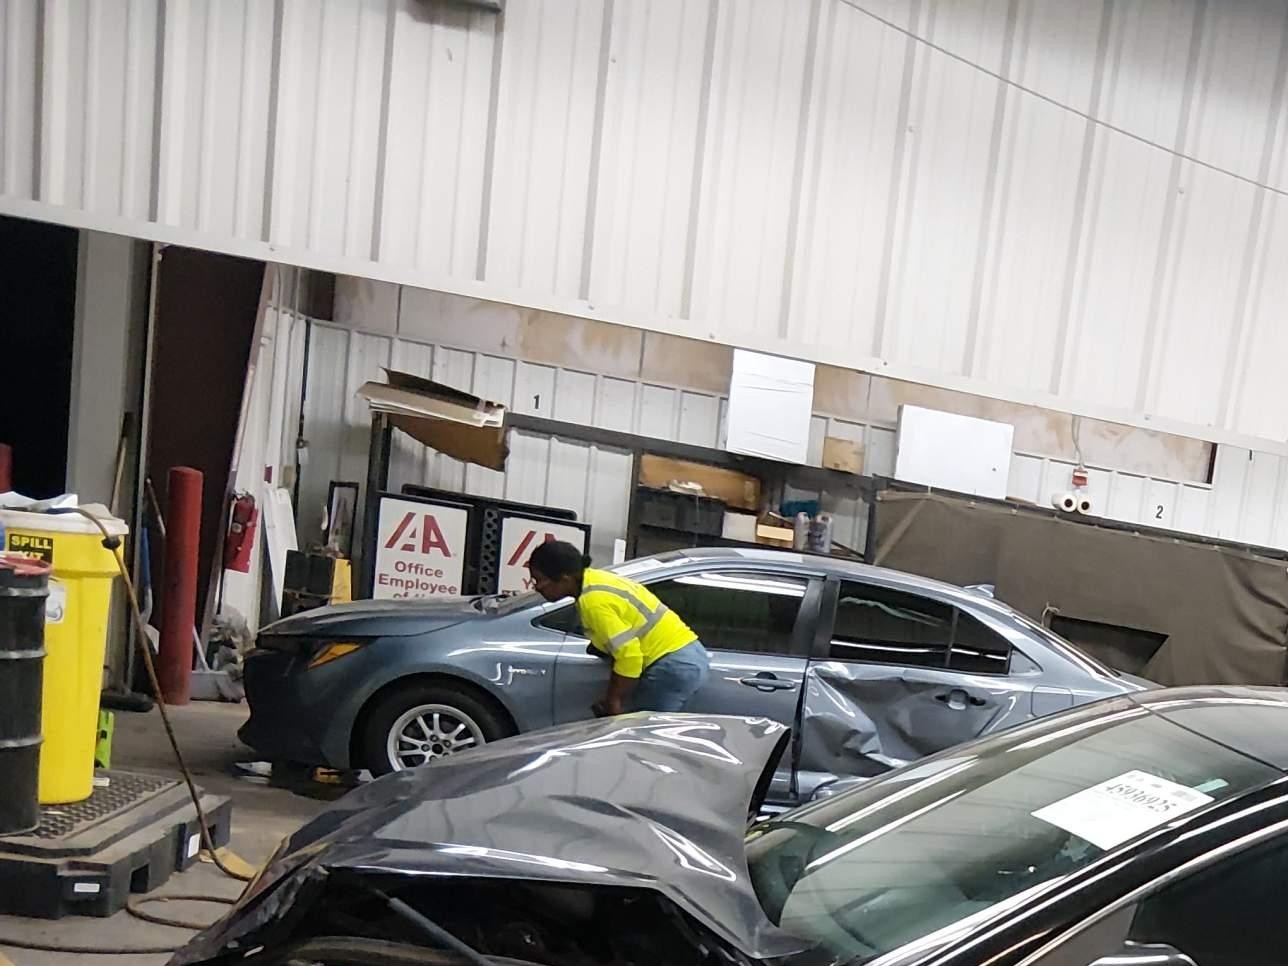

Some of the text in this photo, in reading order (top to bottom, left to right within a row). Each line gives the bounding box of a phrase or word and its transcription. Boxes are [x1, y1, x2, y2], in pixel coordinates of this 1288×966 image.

[533, 394, 540, 410] 1
[1155, 504, 1164, 519] 2
[11, 535, 52, 549] SPILL
[394, 560, 444, 578] Office
[378, 573, 458, 595] Employee
